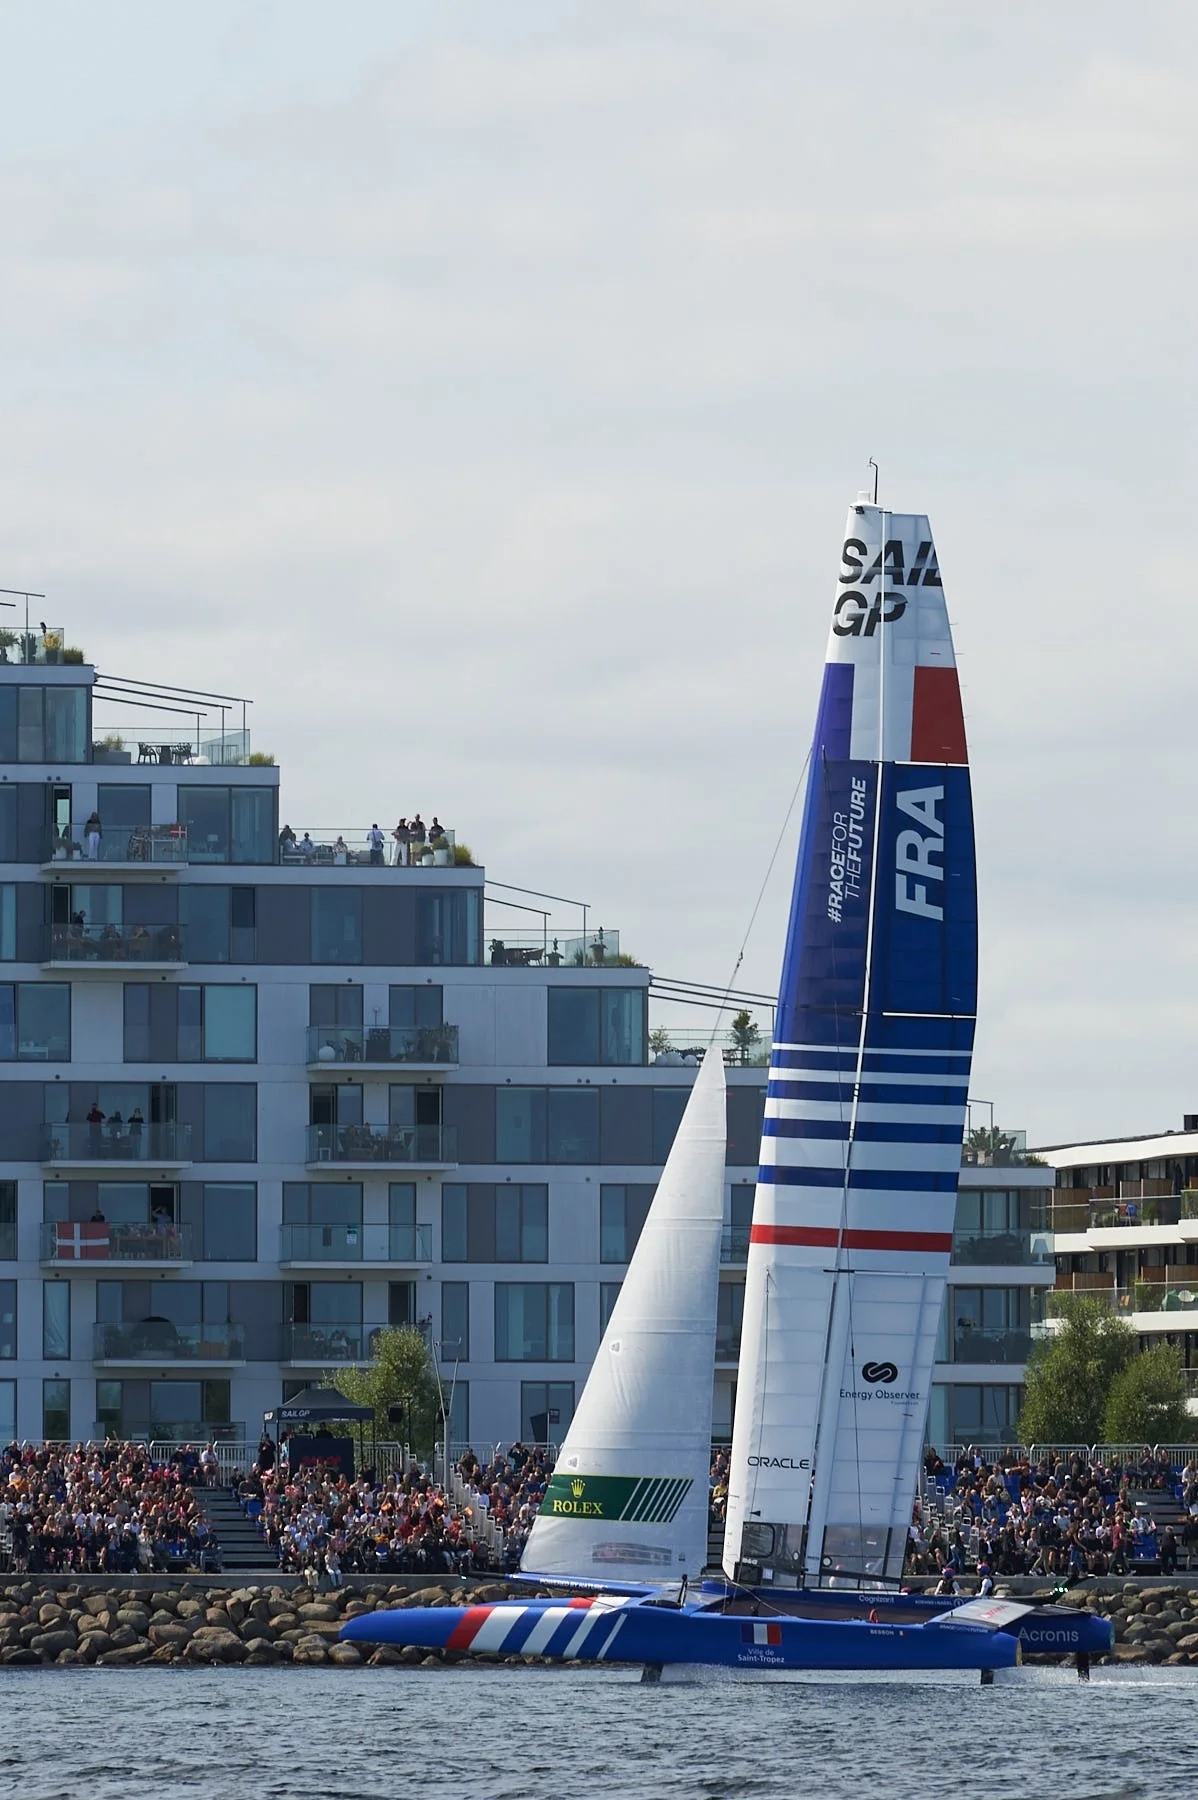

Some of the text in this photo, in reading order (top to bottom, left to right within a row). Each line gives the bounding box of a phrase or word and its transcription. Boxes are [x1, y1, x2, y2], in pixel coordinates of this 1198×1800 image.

[838, 538, 943, 587] SAIL
[832, 591, 908, 638] GP
[845, 777, 866, 899] THEFUTURE
[895, 785, 945, 921] FRA
[828, 812, 848, 923] #RACEFOR
[839, 1389, 920, 1401] Energy Observer
[747, 1455, 810, 1470] ORACLE
[552, 1499, 604, 1516] ROLEX
[858, 1595, 895, 1605] Cognizant
[1018, 1627, 1080, 1643] Acronis
[737, 1654, 785, 1664] Saint-Tropez
[765, 1648, 775, 1657] de
